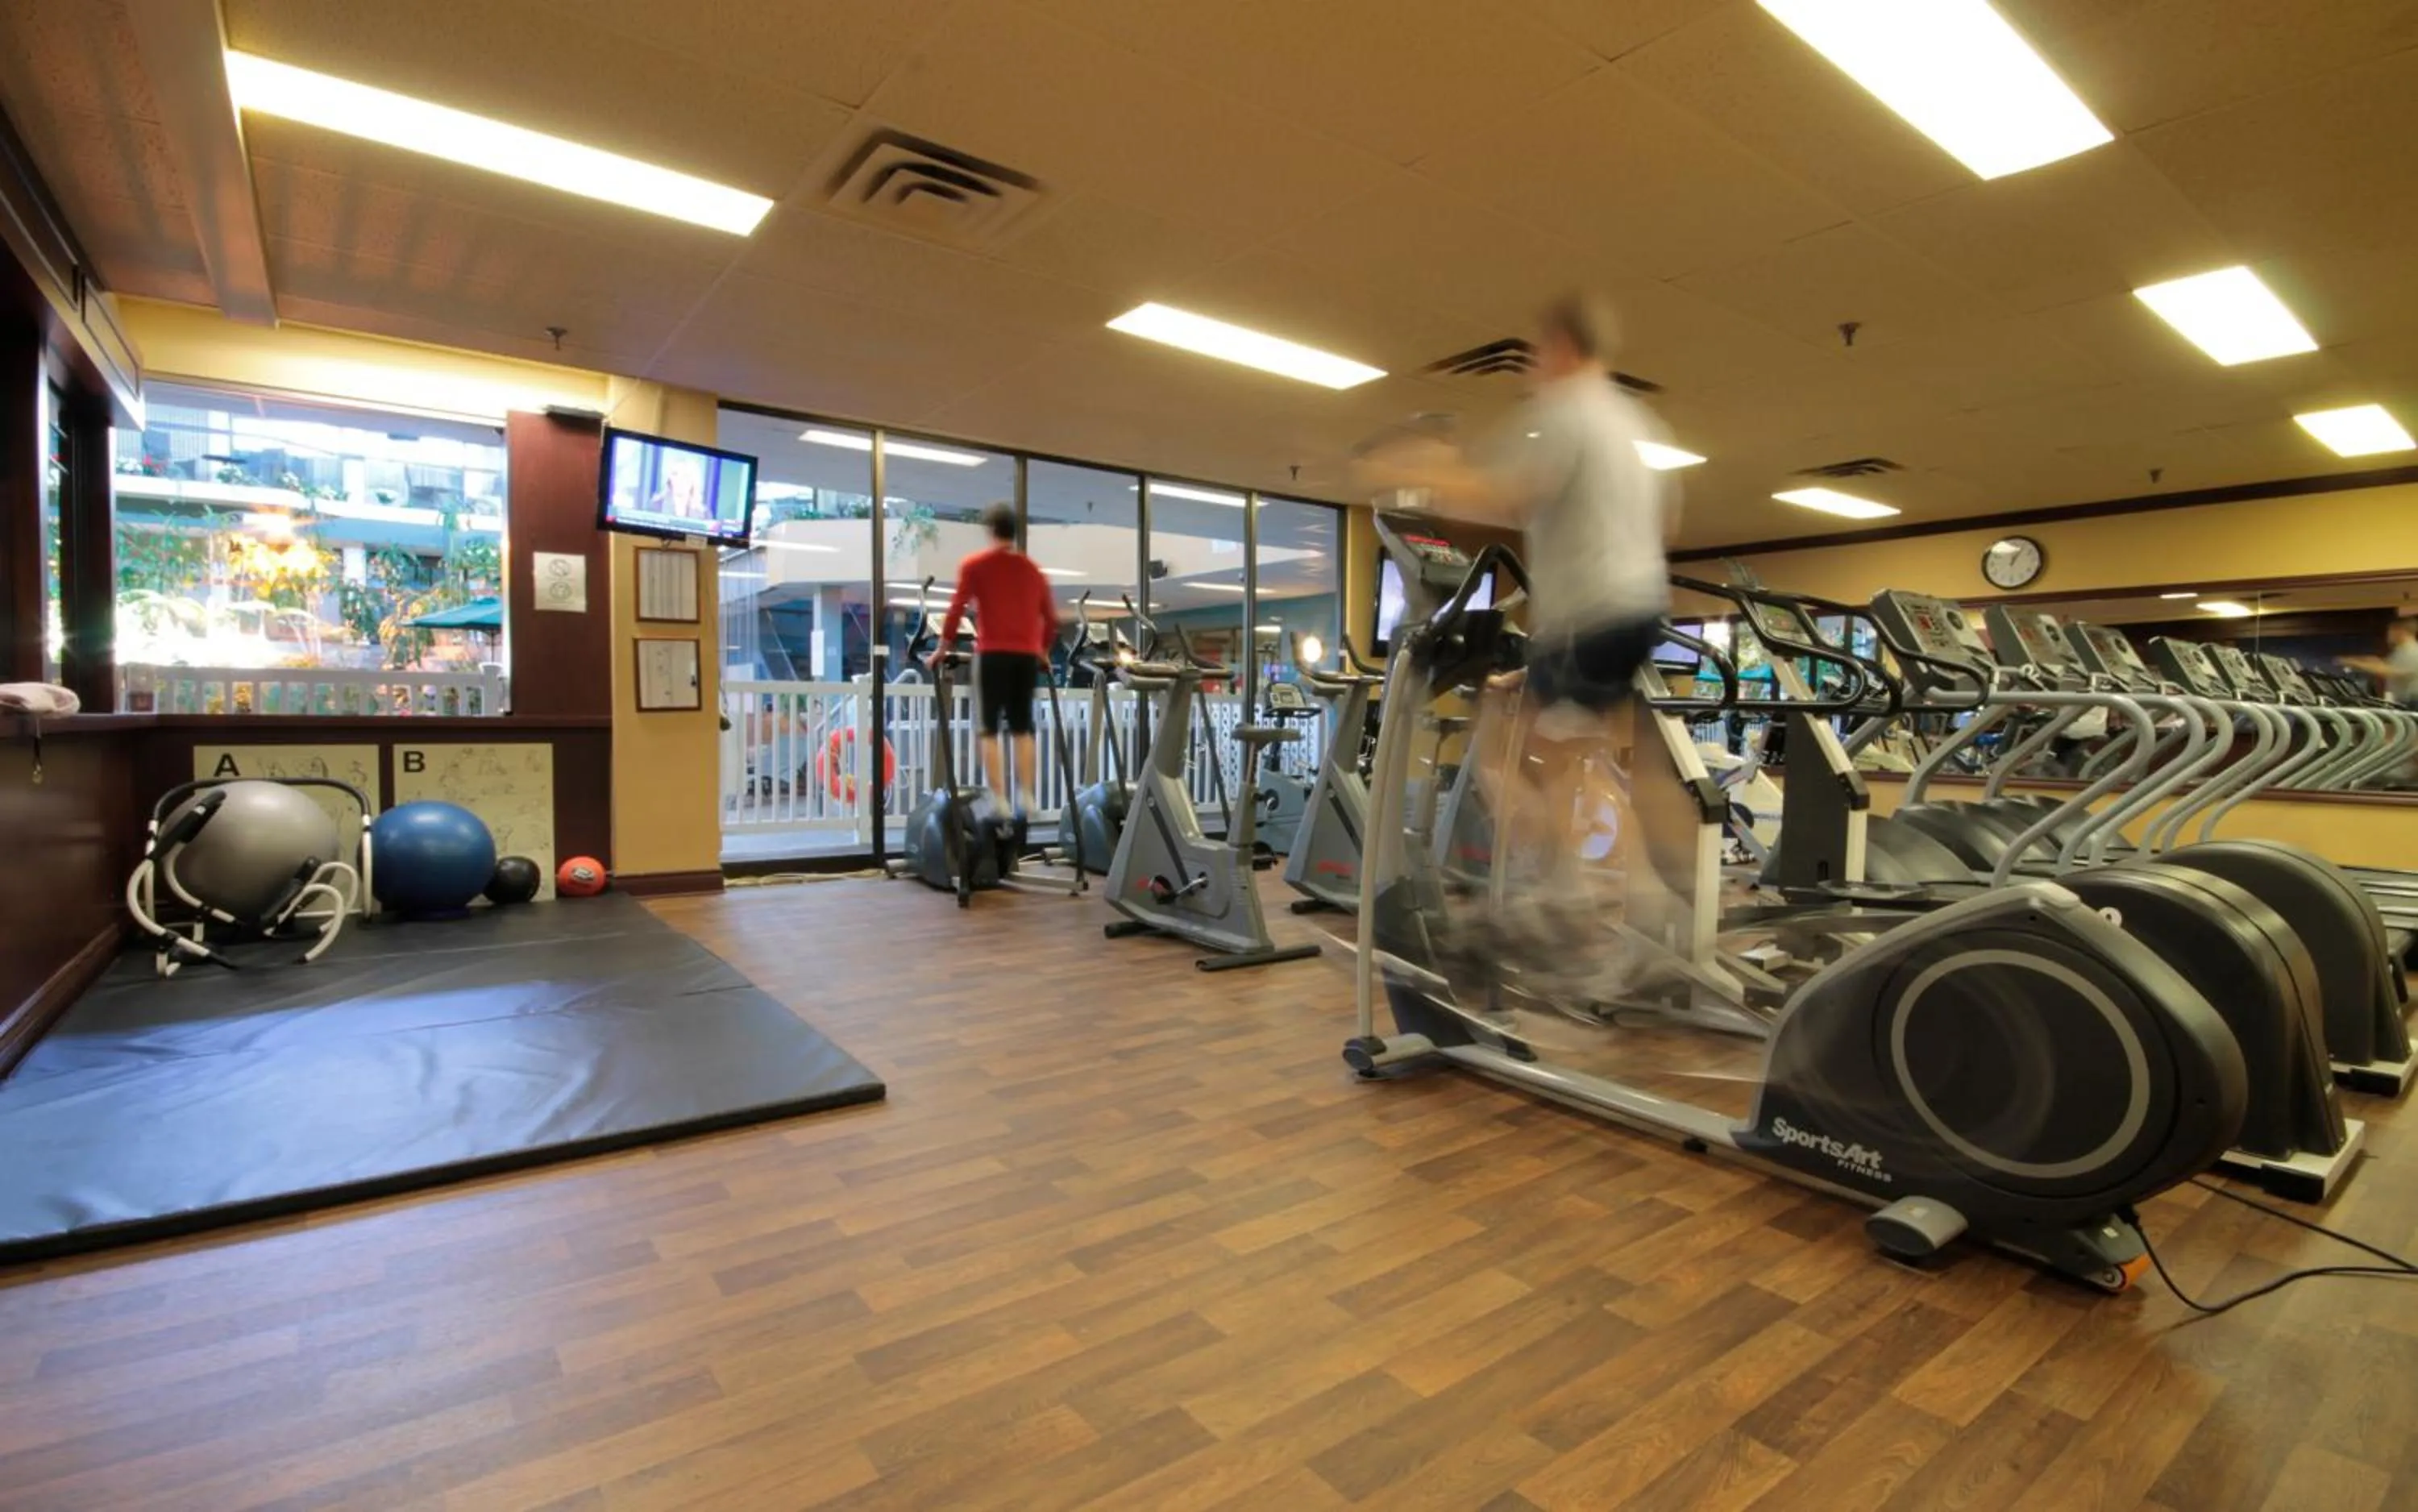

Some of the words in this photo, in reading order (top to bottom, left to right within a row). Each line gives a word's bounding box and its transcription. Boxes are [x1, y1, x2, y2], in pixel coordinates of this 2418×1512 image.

[214, 753, 240, 777] A
[403, 750, 426, 773] B
[1772, 1116, 1883, 1169] SportsArt
[1838, 1159, 1892, 1182] FITNESS
